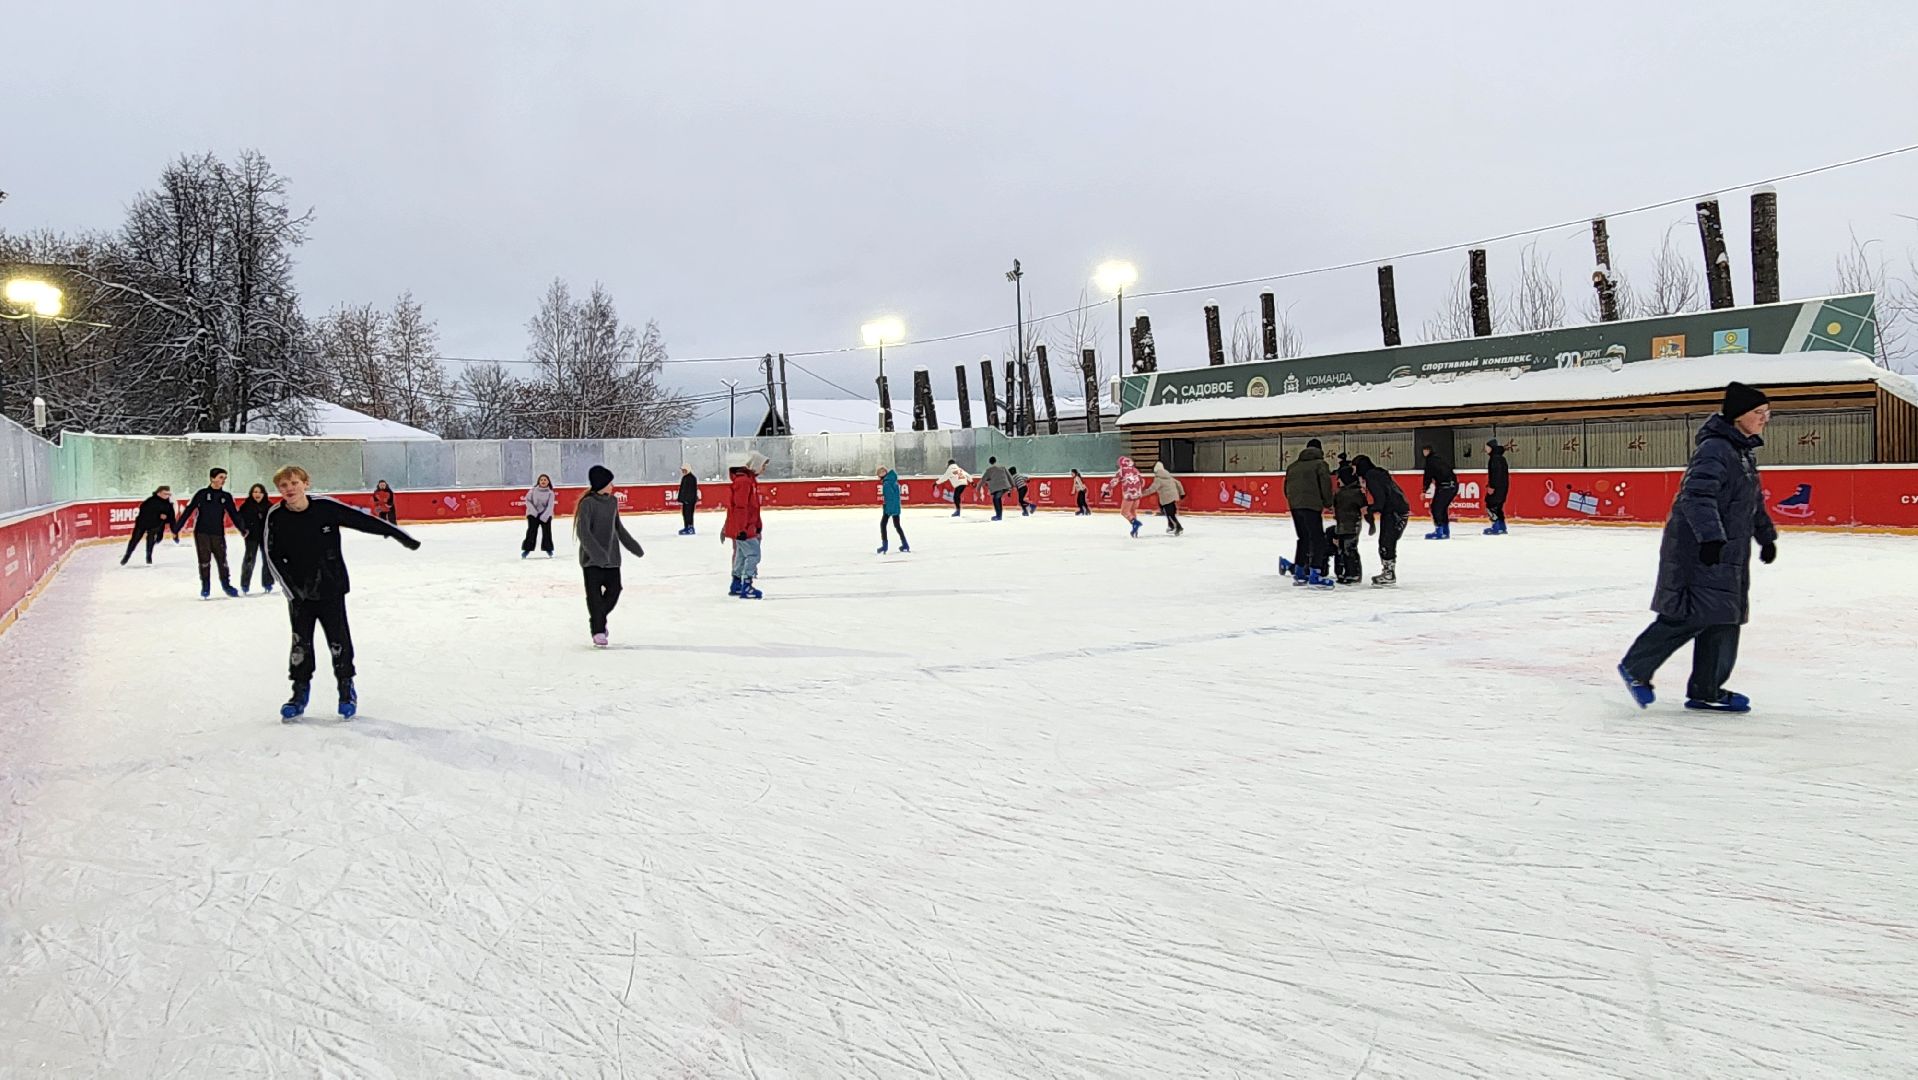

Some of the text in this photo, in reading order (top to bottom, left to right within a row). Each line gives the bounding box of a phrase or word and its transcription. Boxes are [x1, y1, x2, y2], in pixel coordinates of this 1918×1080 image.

[1482, 354, 1532, 366] комплекс
[1305, 373, 1353, 386] КОМАНДА
[1181, 381, 1234, 398] САДОВОЕ
